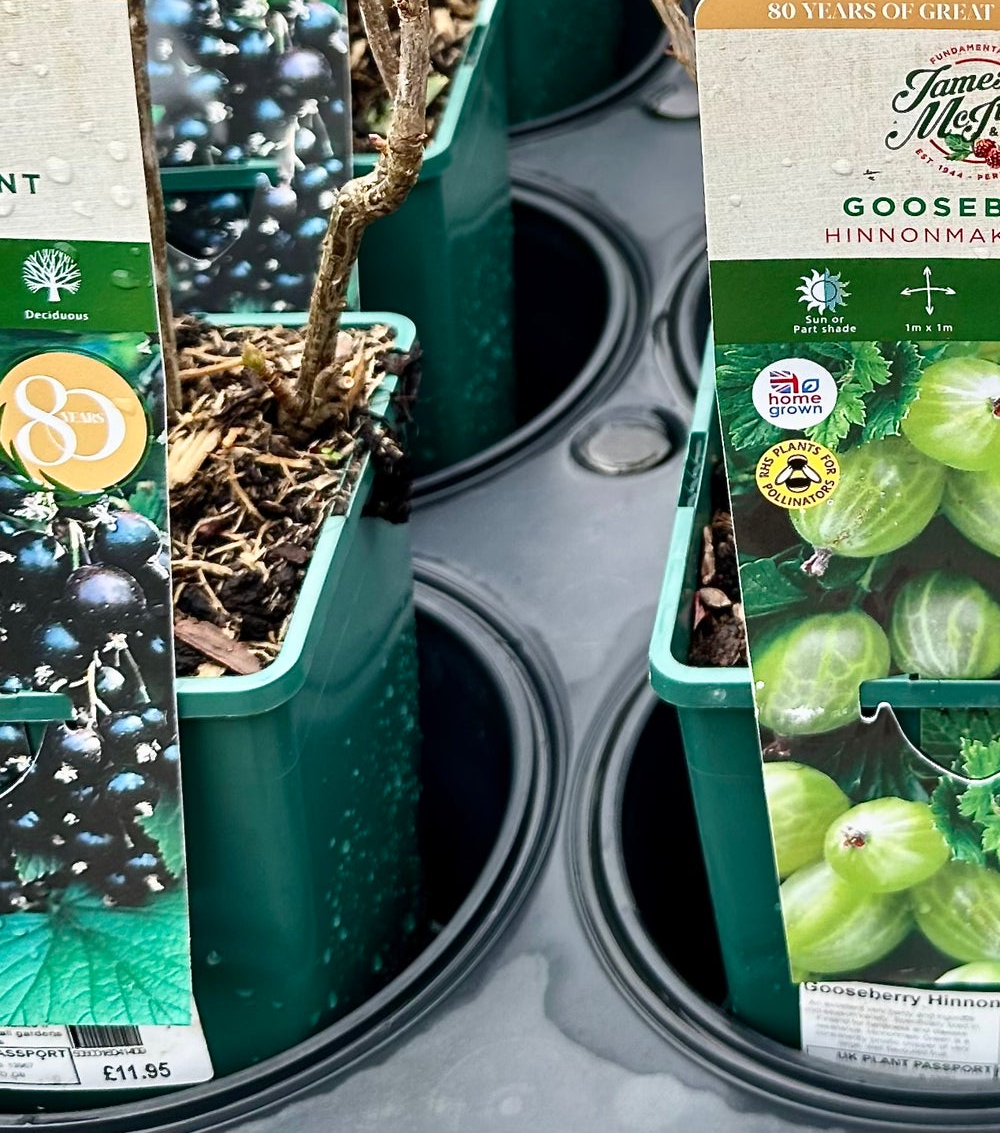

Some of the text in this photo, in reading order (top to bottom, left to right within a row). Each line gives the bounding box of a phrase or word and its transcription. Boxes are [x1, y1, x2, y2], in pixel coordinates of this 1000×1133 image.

[767, 1, 797, 20] 80
[800, 2, 876, 20] YEARS
[882, 2, 914, 21] OF
[919, 3, 995, 22] GREAT
[989, 127, 999, 137] &
[938, 164, 964, 179] 1944
[25, 309, 89, 321] Deciduous
[805, 315, 844, 325] Sun or
[793, 324, 857, 335] Part shade
[905, 323, 922, 333] 1m
[936, 323, 953, 333] 1m
[768, 393, 822, 405] home
[60, 411, 105, 424] YEARS
[769, 404, 823, 418] grown
[14, 375, 126, 467] 80
[759, 441, 837, 478] RHS PLANTS FOR
[762, 479, 835, 507] POLLINATORS
[804, 981, 921, 1006] Gooseberry
[838, 1051, 857, 1061] UK
[862, 1054, 909, 1066] PLANT
[914, 1059, 992, 1073] PASSPORT
[104, 1062, 171, 1081] £11.95
